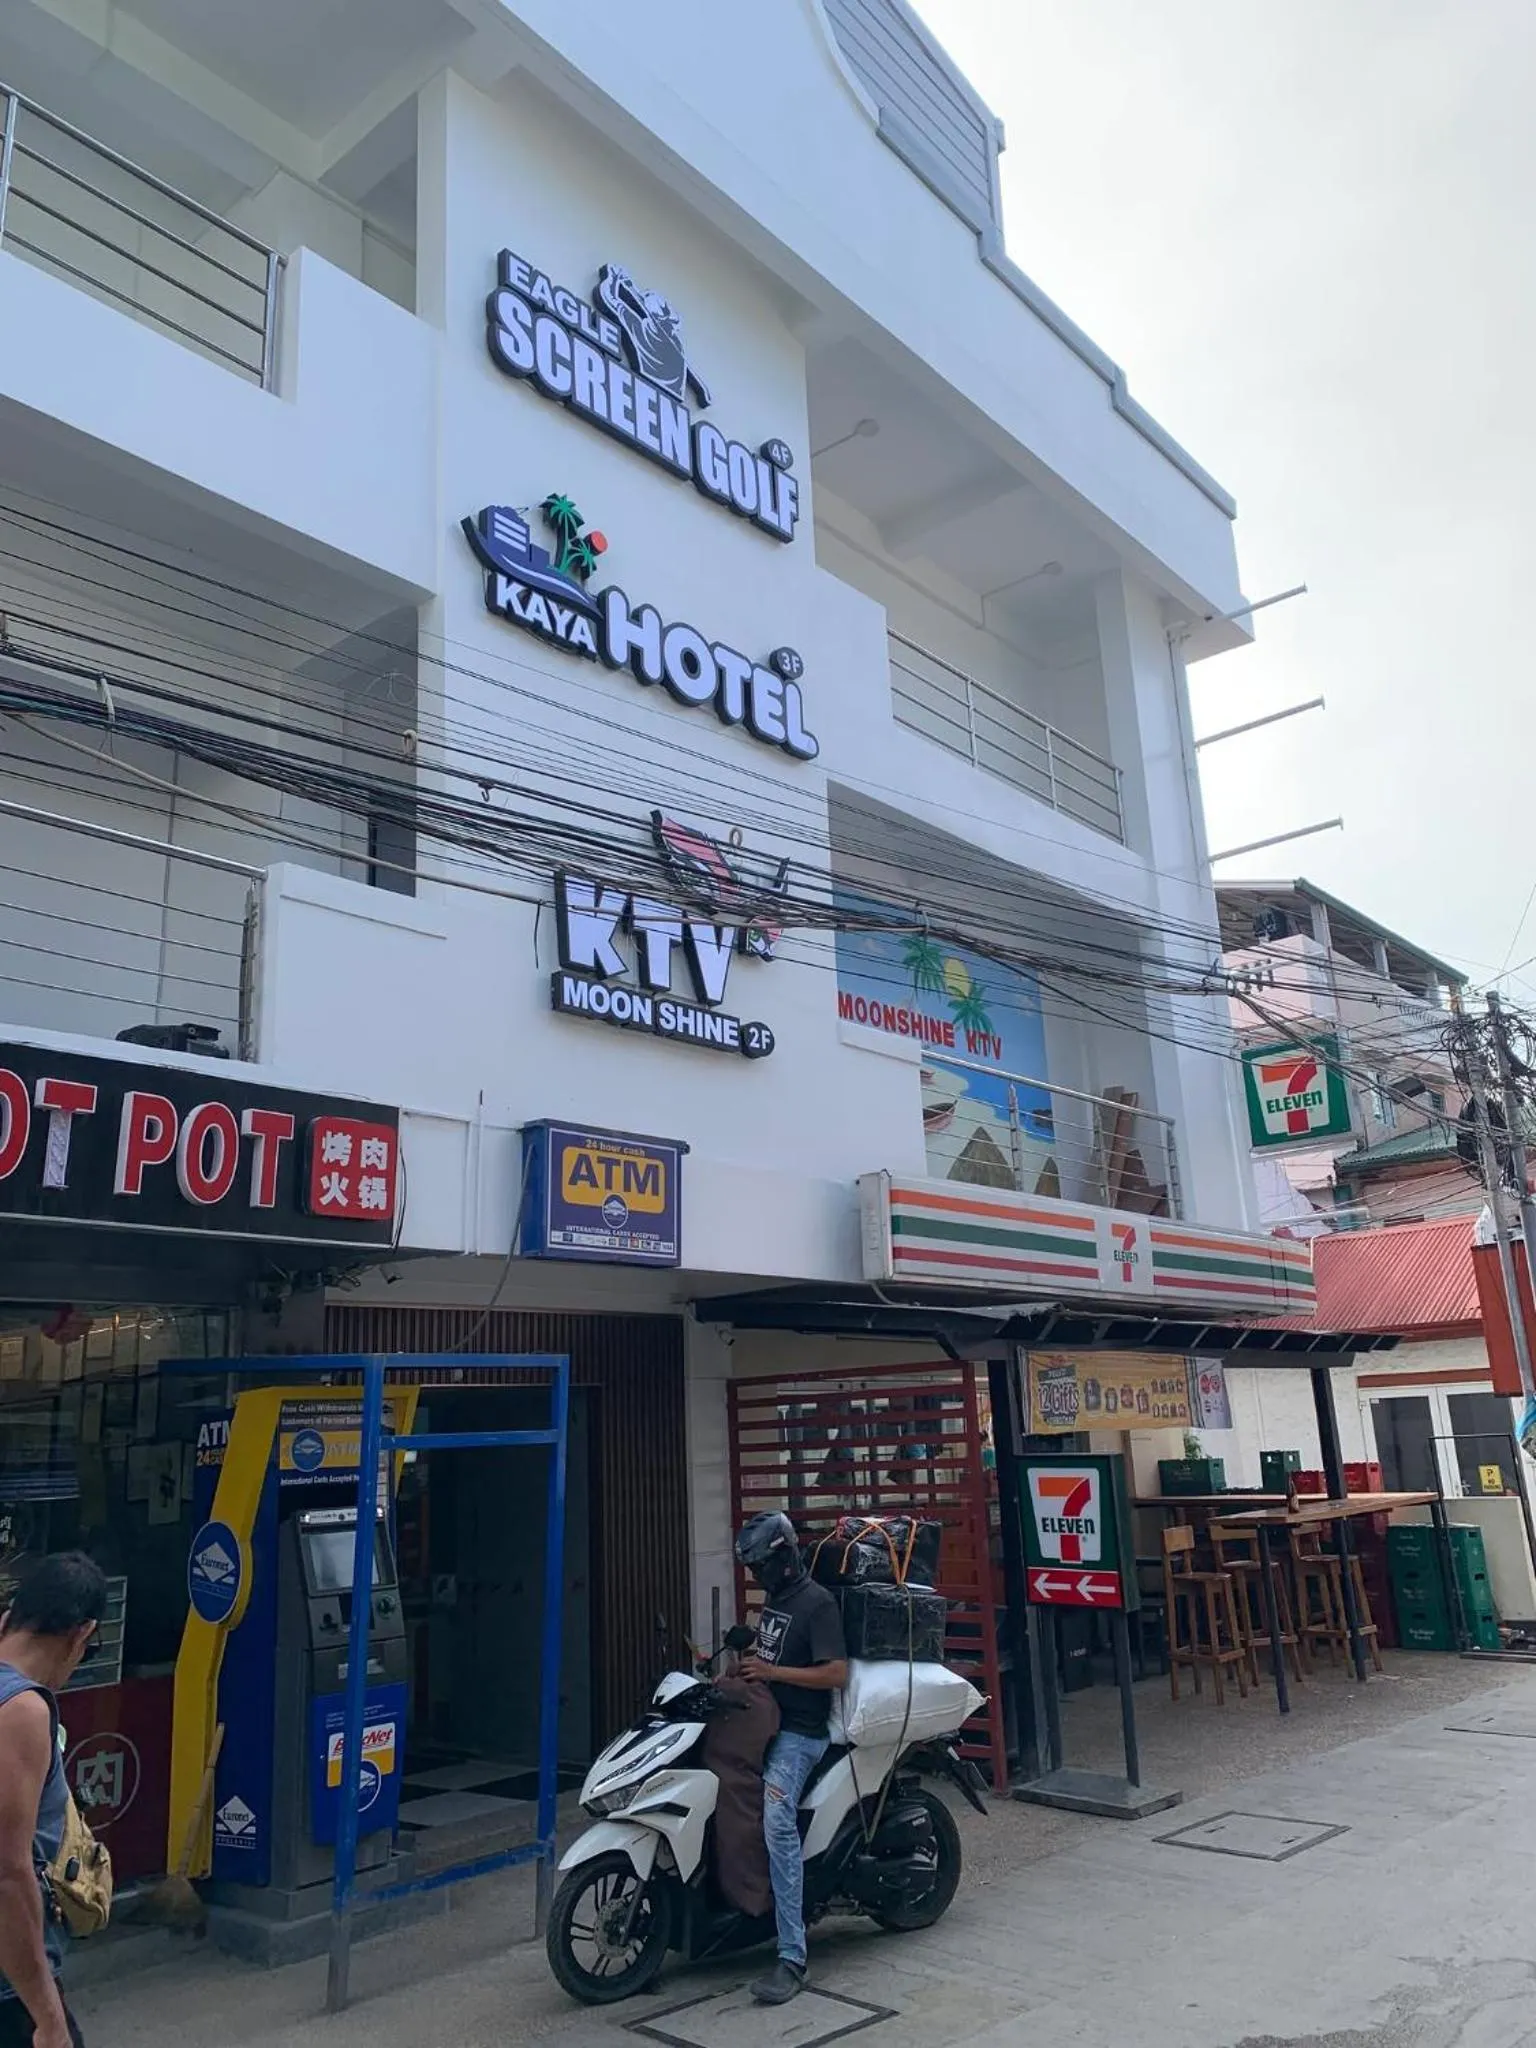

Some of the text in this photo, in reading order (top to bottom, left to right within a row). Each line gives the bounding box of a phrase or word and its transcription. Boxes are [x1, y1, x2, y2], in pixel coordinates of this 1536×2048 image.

[508, 253, 620, 355] EAGLE
[496, 290, 799, 540] SCREEN GOLF
[769, 442, 791, 465] 4F
[495, 573, 598, 653] KAYA
[606, 590, 819, 758] HOTEL
[780, 652, 802, 674] 3F
[564, 873, 737, 1003] KTV
[562, 975, 741, 1048] MOON SHINE
[748, 1026, 772, 1050] 2F
[836, 989, 1003, 1061] MOONSHINE KTV
[112, 1089, 296, 1210] POT
[320, 1129, 389, 1171] 烤肉
[567, 1153, 660, 1197] ATM
[319, 1170, 388, 1211] 火锅
